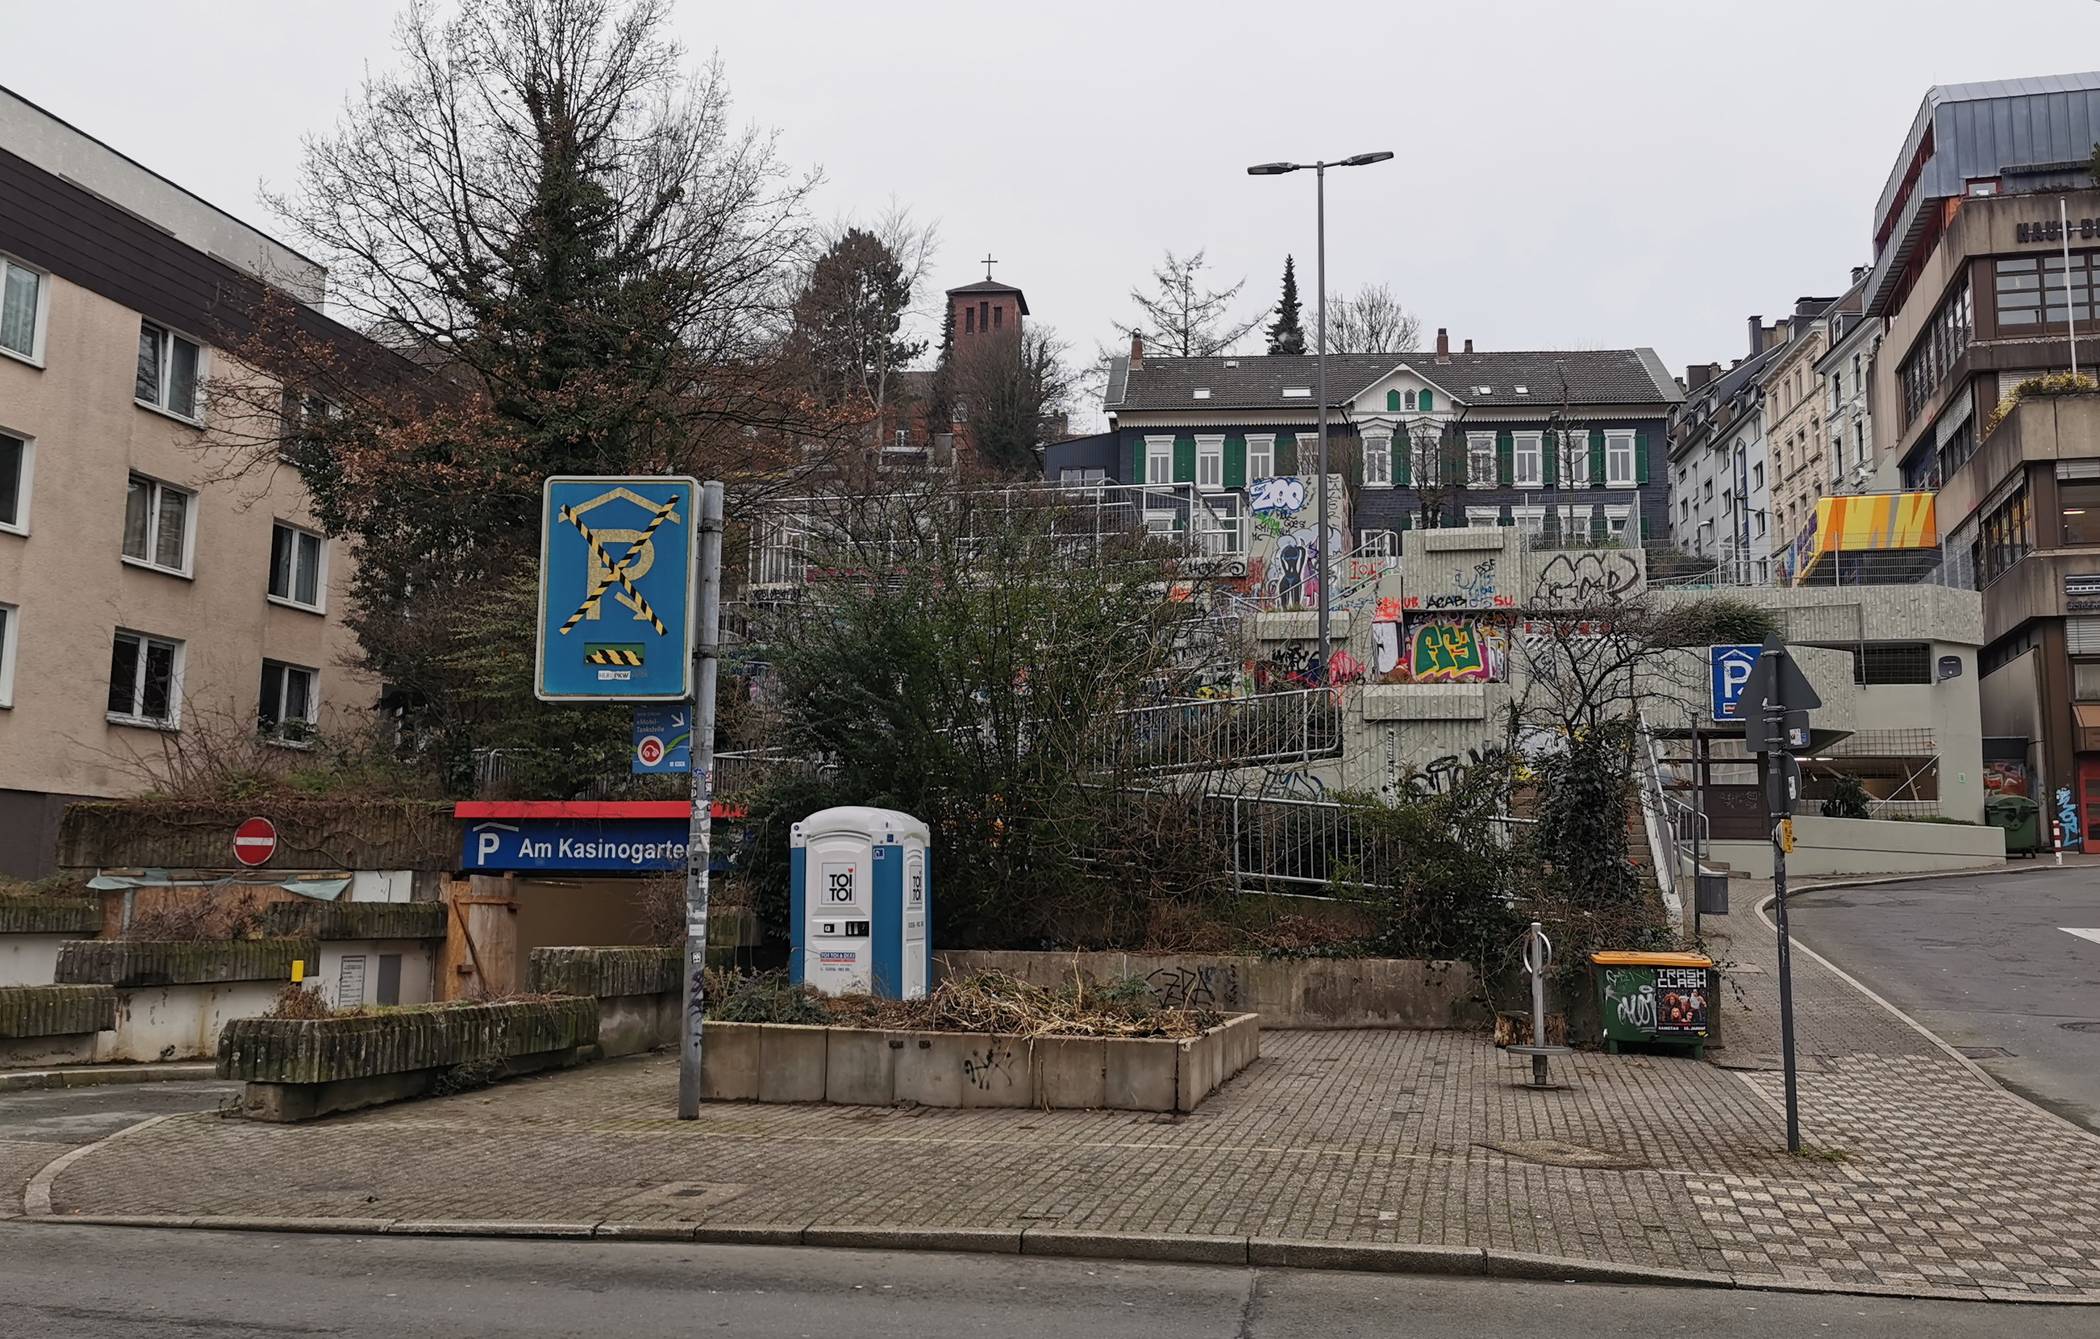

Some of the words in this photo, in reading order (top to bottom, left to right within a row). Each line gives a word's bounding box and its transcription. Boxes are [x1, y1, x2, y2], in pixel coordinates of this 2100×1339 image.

[1723, 660, 1752, 698] P
[477, 833, 500, 865] P
[519, 838, 551, 858] Am
[829, 873, 852, 887] TOI
[829, 887, 852, 902] TOI
[1657, 969, 1707, 979] TRASH
[1657, 978, 1707, 988] CLASH
